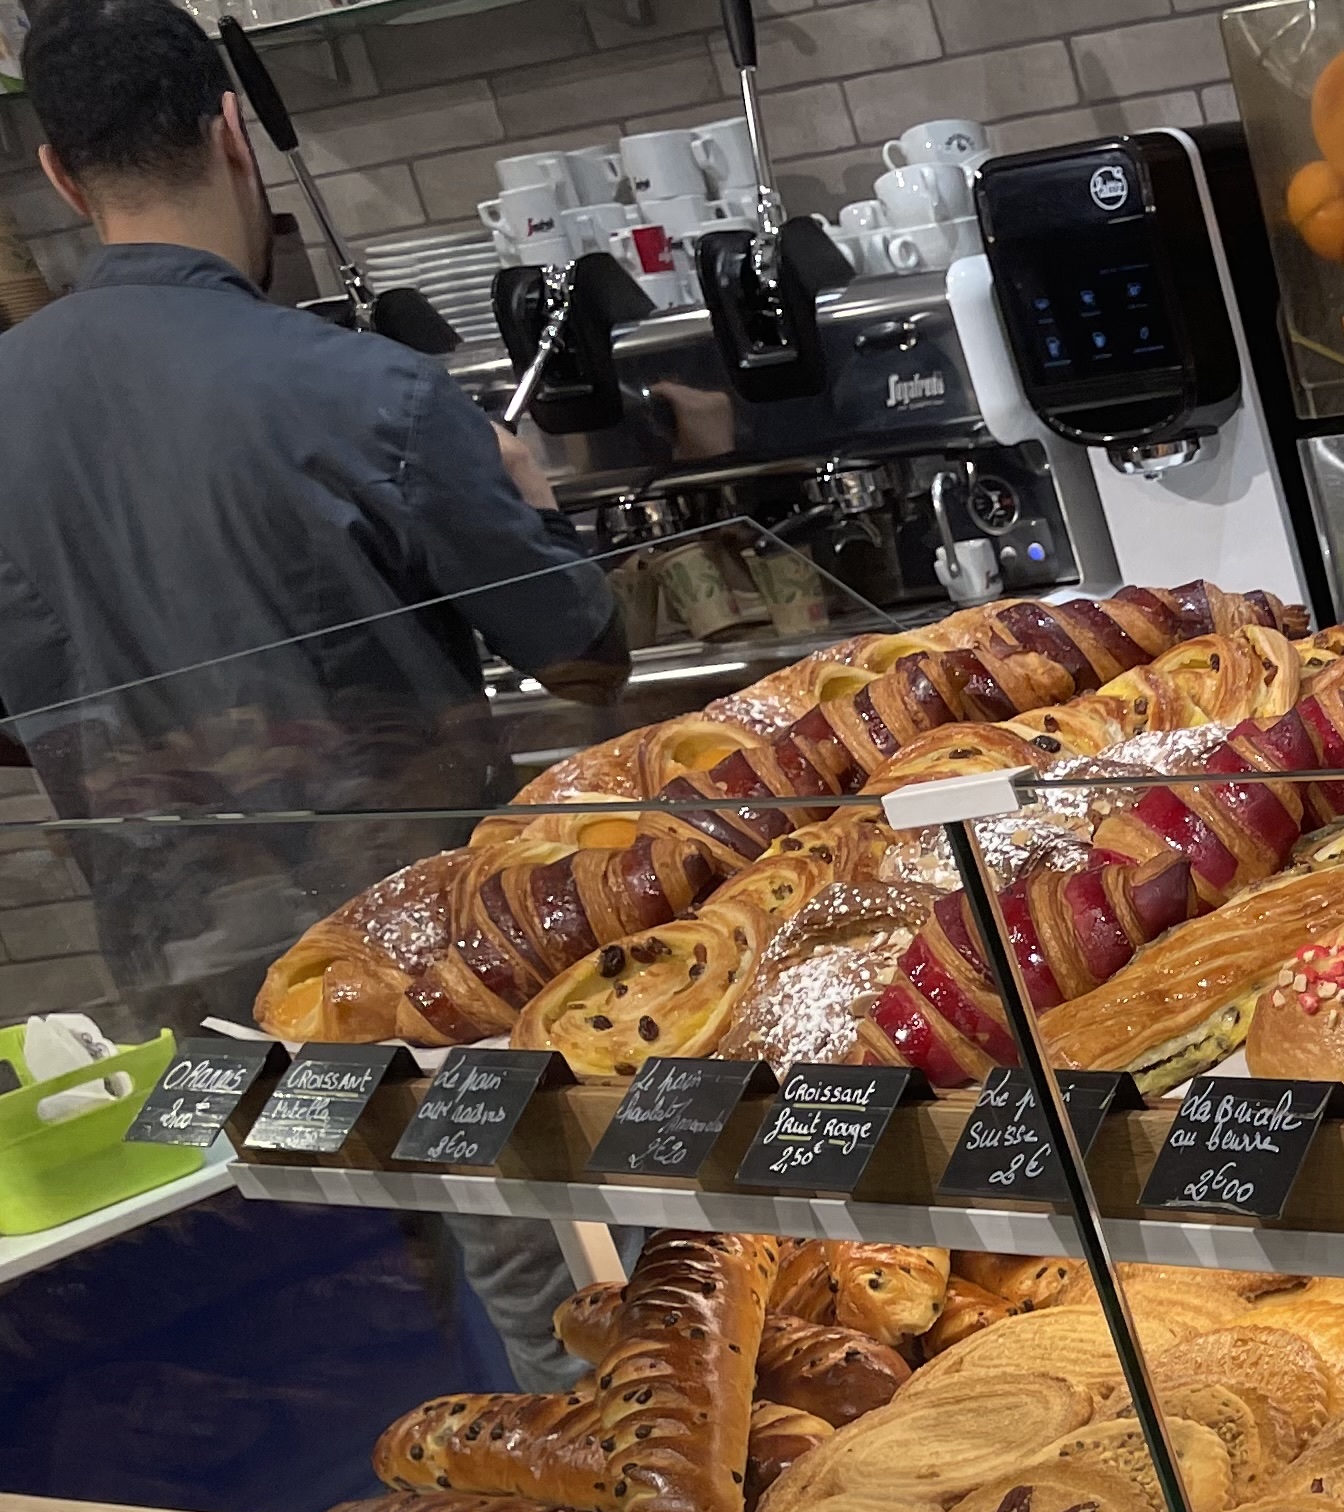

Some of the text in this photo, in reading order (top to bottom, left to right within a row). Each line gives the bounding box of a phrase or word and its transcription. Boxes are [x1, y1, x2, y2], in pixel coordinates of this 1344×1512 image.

[433, 1054, 508, 1103] Le pain
[654, 1066, 703, 1103] pain
[976, 1069, 1011, 1108] Le
[965, 1120, 1040, 1151] Suisse
[1169, 1122, 1281, 1155] au beurre
